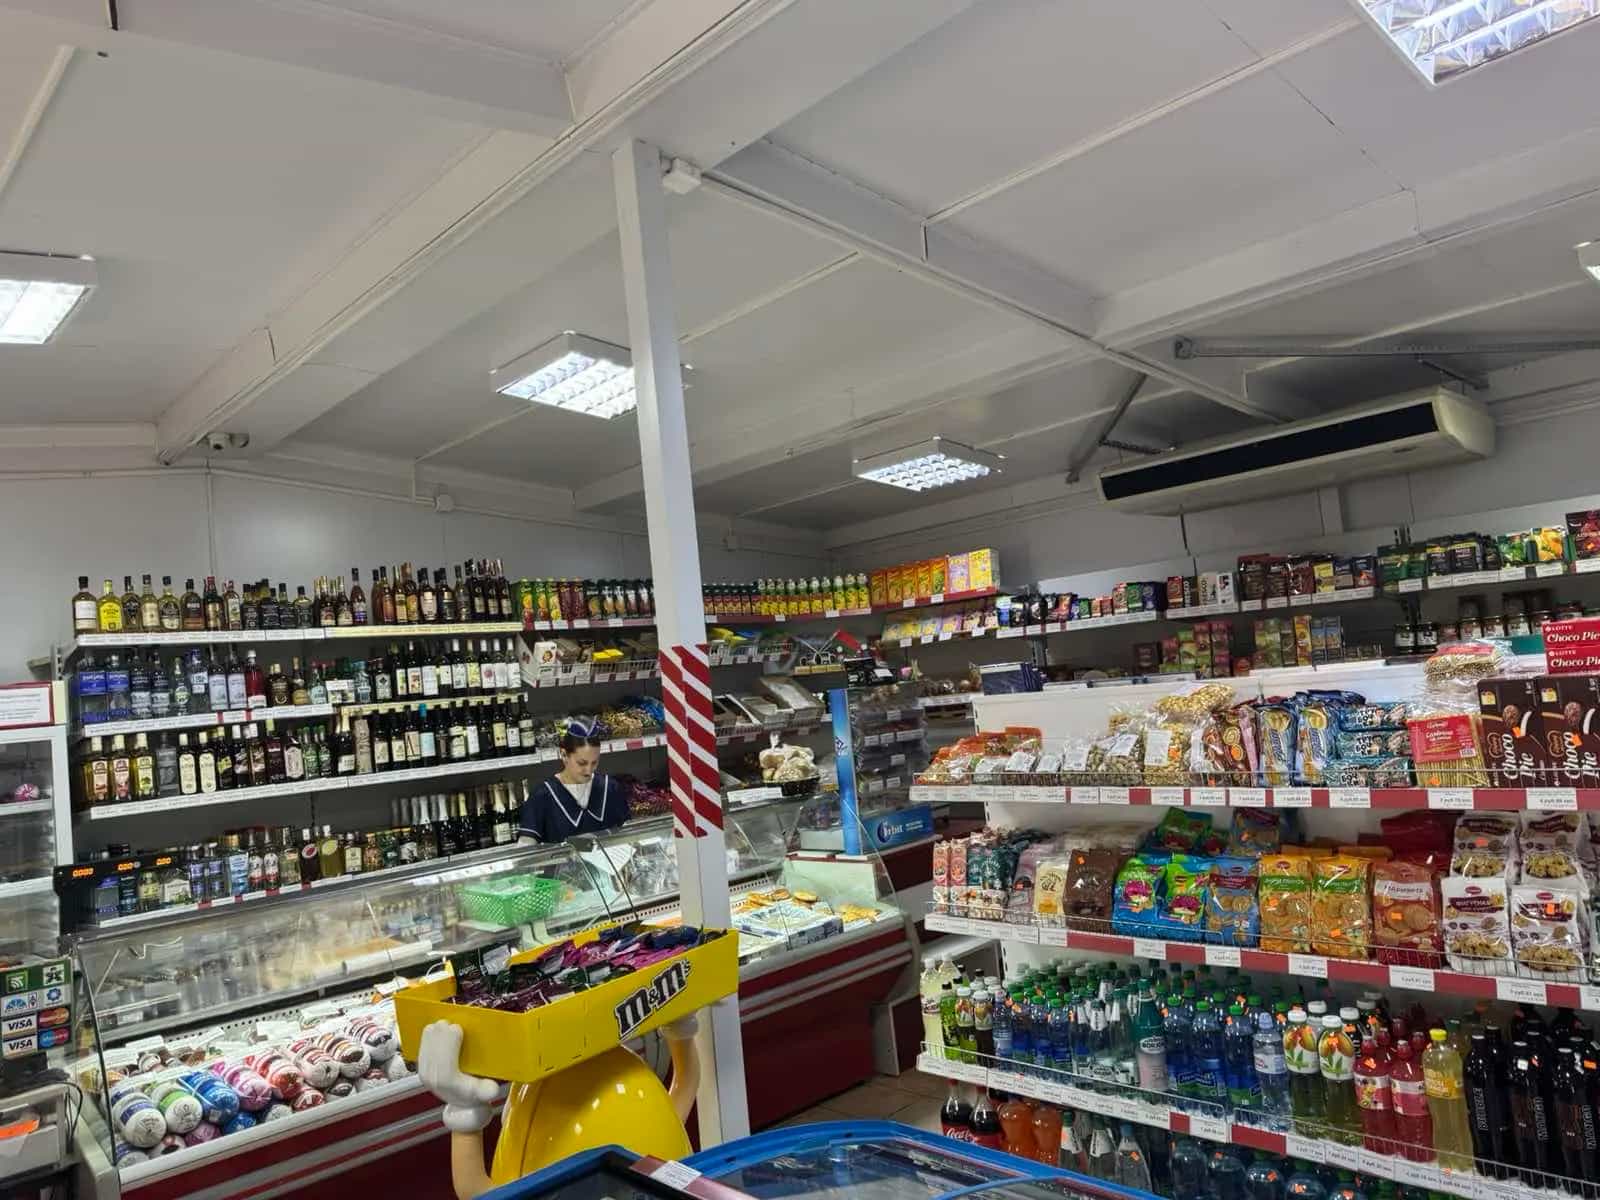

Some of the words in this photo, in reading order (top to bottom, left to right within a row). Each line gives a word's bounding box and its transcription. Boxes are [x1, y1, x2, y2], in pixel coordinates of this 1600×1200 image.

[1547, 632, 1580, 643] Choco
[1550, 656, 1584, 668] Choco
[1502, 733, 1518, 780] Choco
[1519, 752, 1536, 778] Pie
[1563, 732, 1581, 780] Choco
[1582, 751, 1598, 777] Pie
[8, 1018, 33, 1031] VISA
[8, 1039, 33, 1051] VISA
